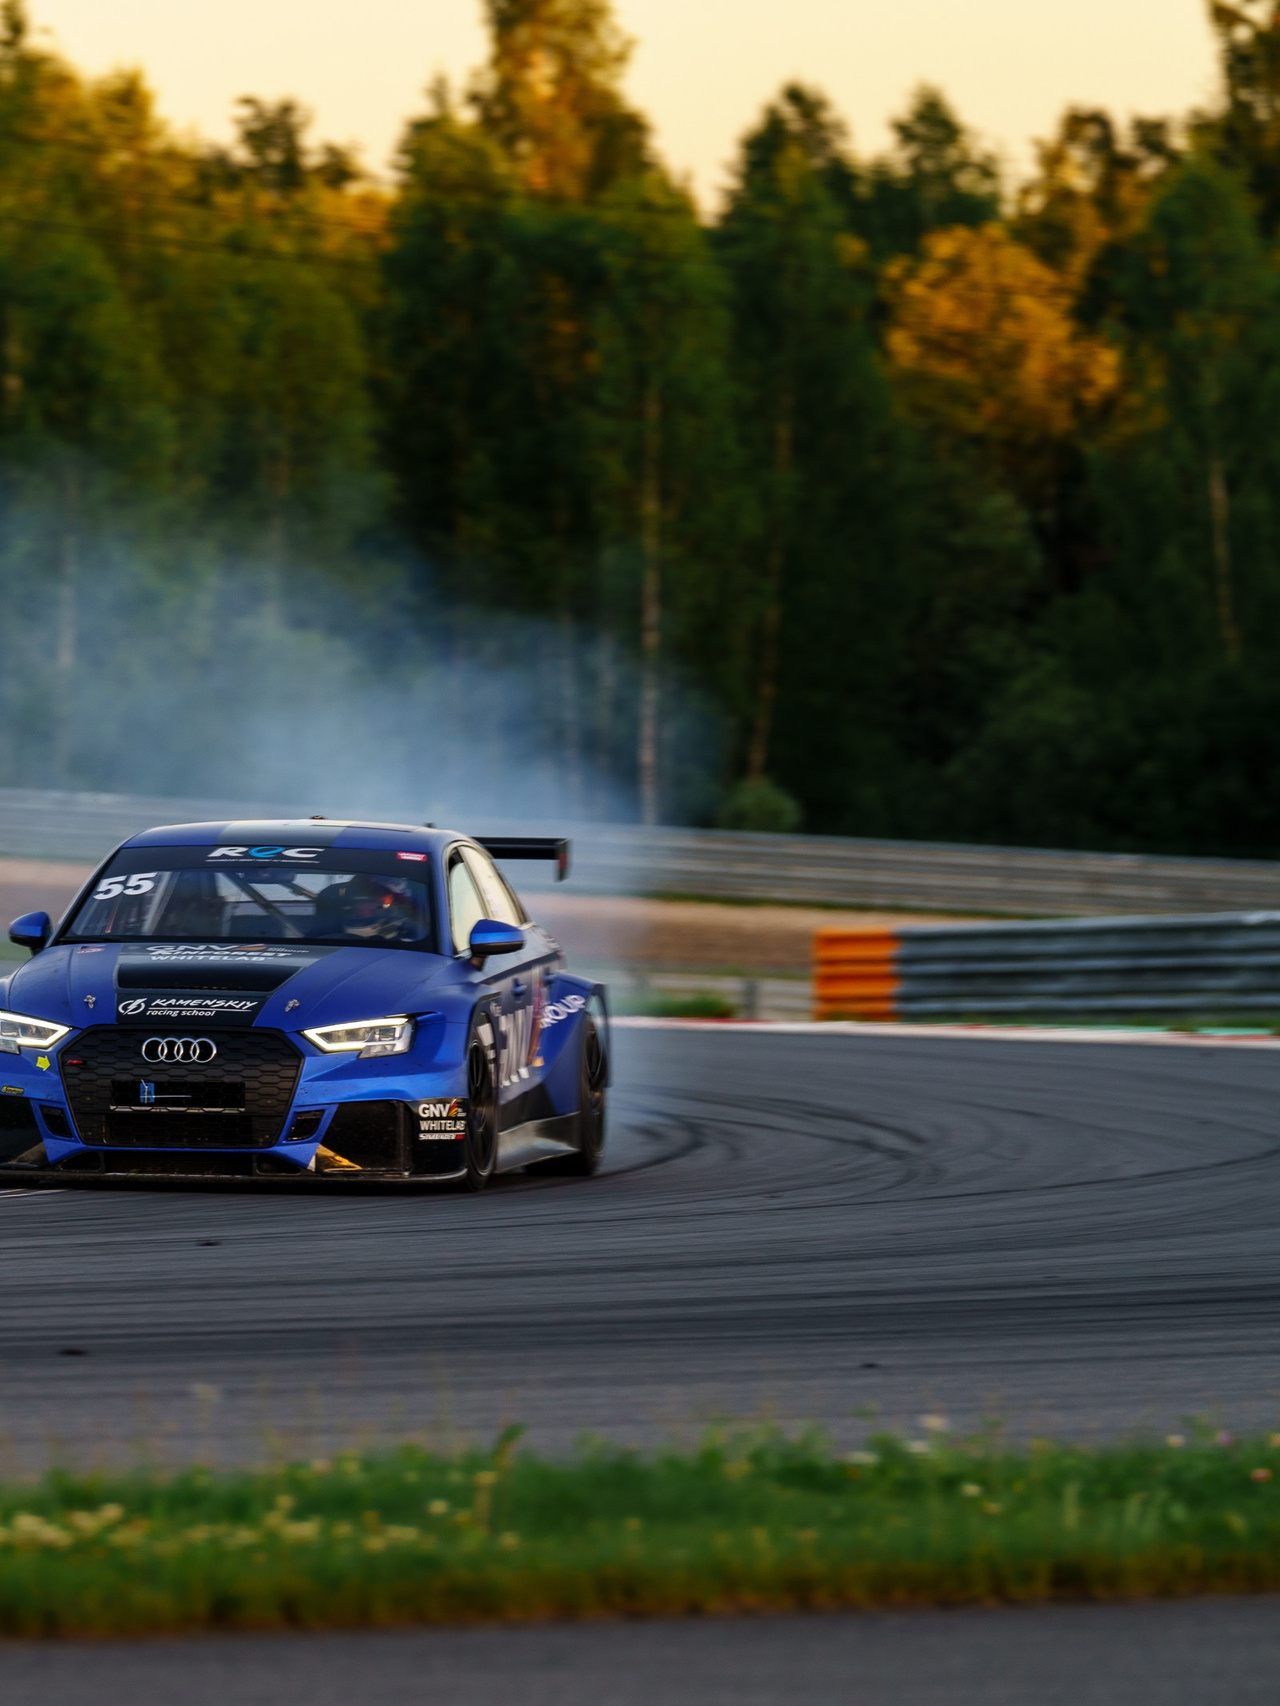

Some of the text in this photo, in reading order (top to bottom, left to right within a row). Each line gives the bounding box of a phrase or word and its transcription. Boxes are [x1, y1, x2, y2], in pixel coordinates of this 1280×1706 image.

[93, 872, 158, 900] 55
[151, 998, 258, 1010] KAMENSKIY
[418, 1103, 451, 1118] GNV
[419, 1120, 466, 1131] WHITELAB
